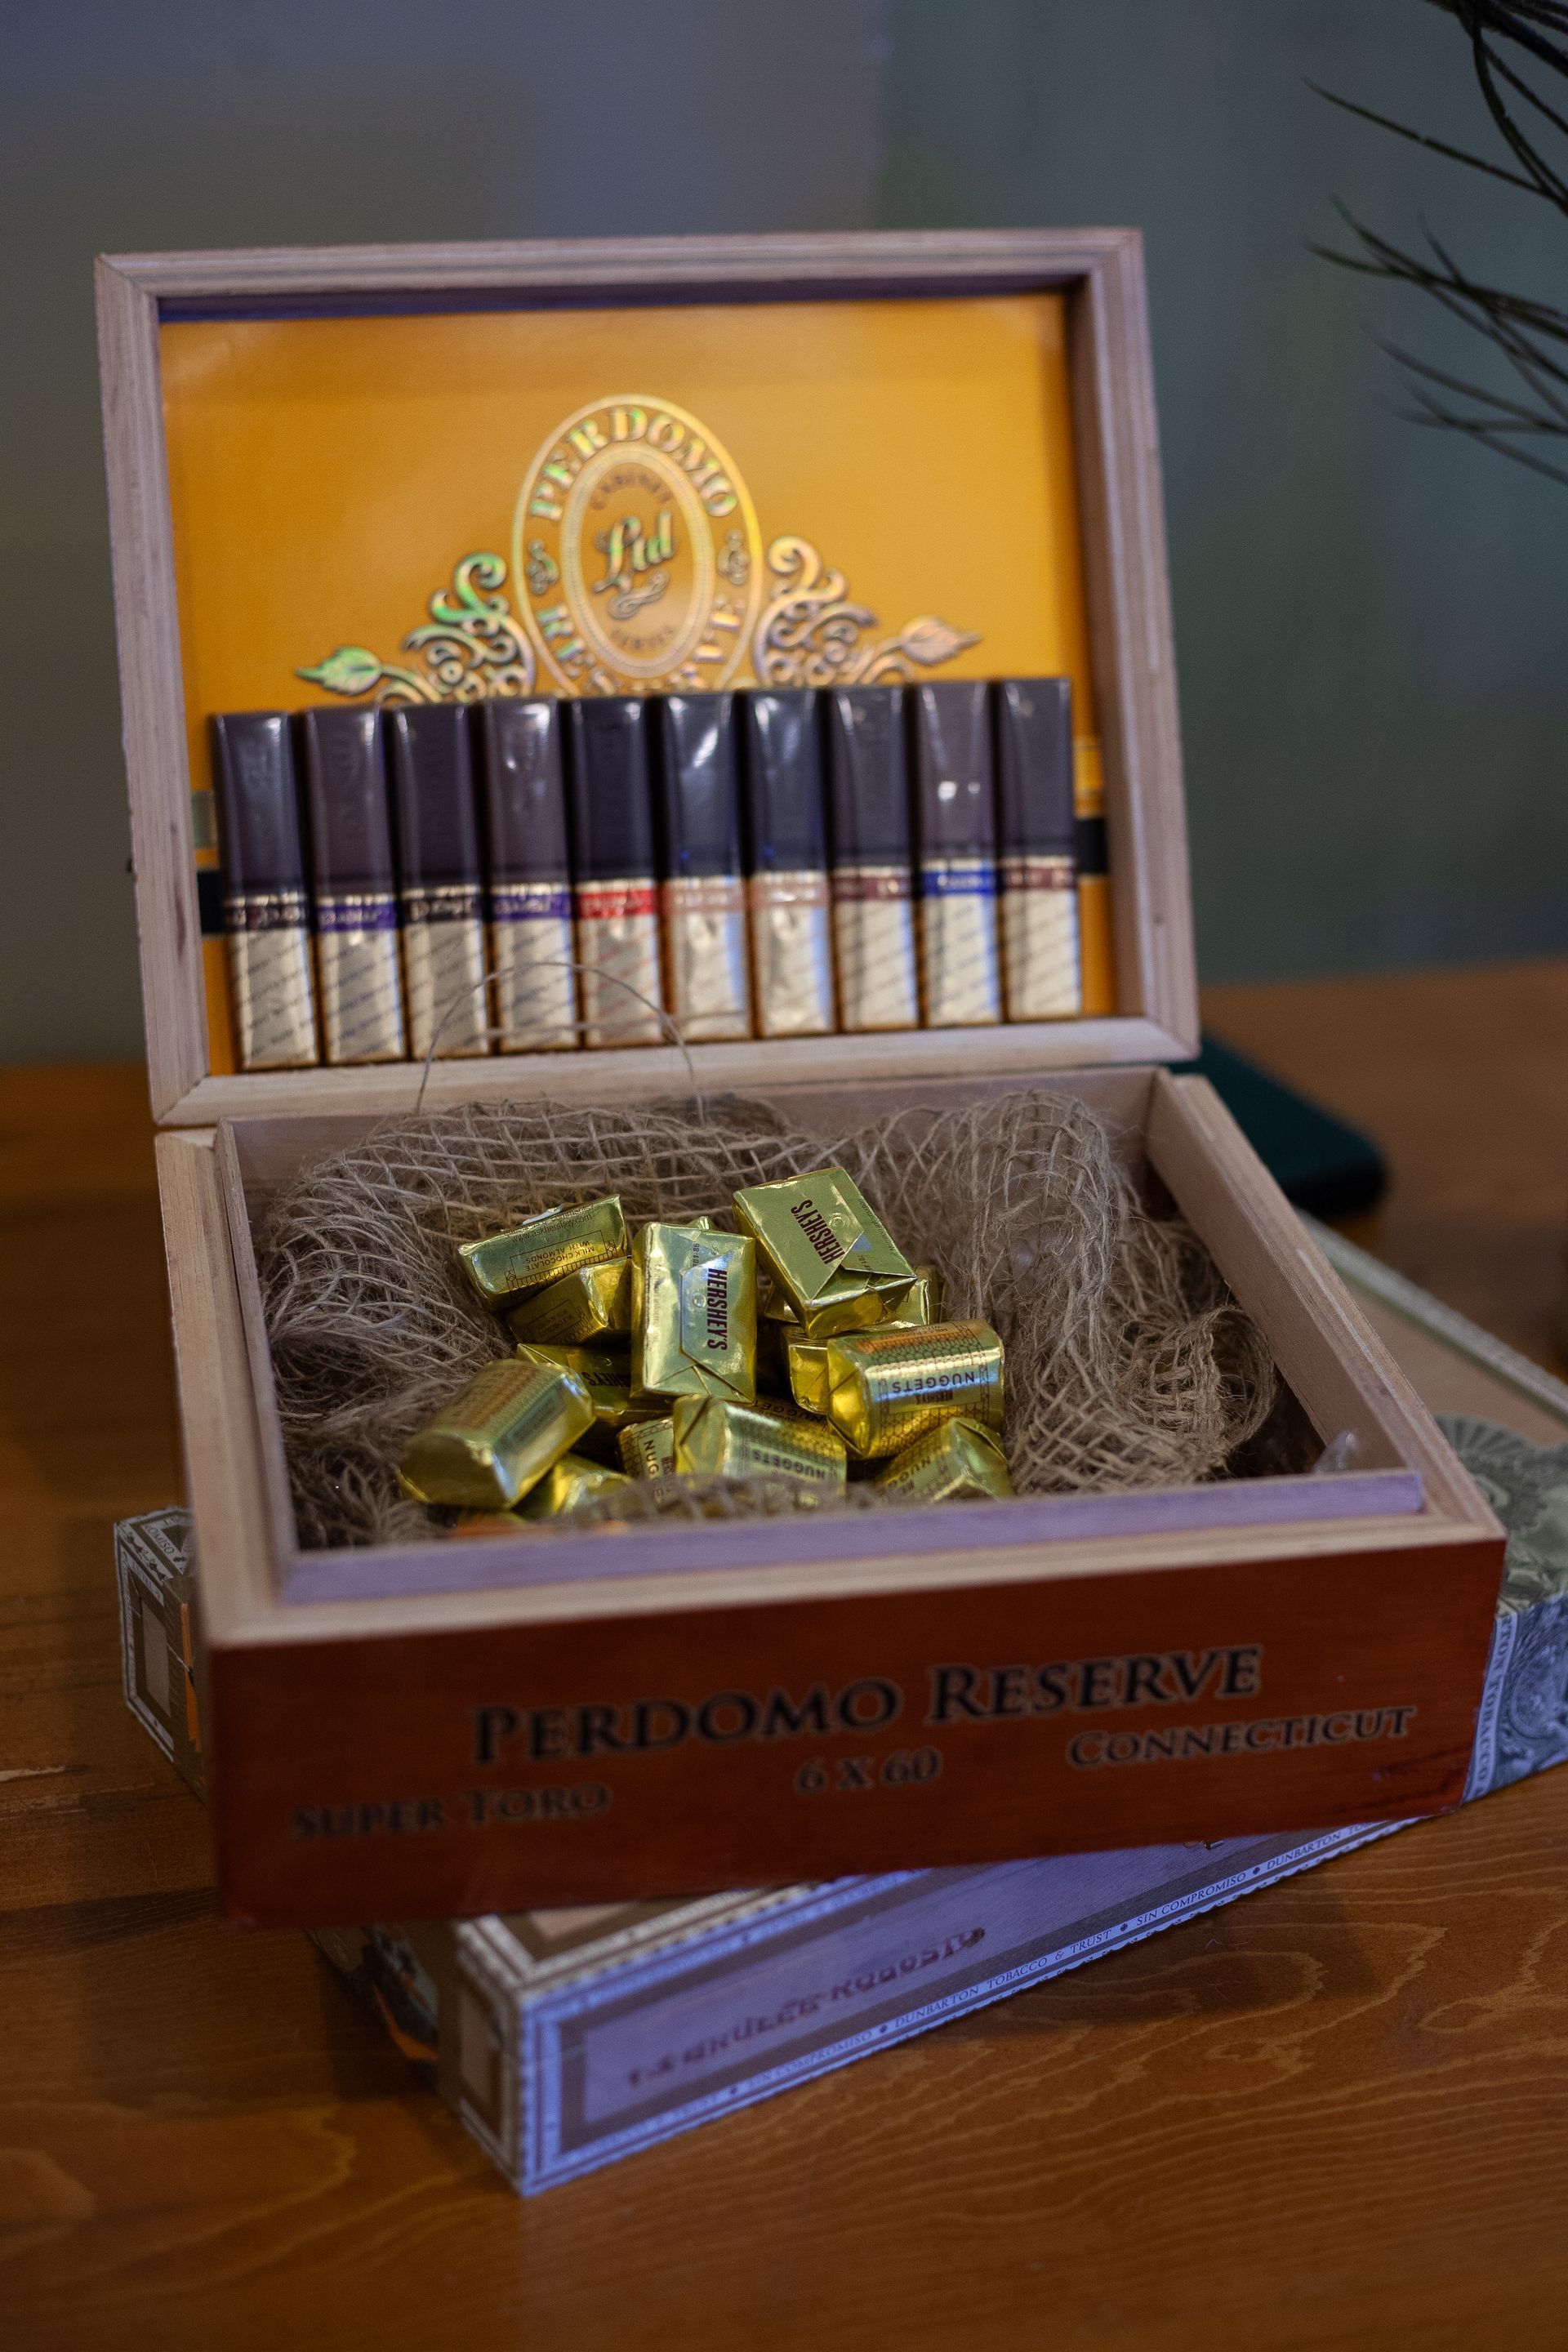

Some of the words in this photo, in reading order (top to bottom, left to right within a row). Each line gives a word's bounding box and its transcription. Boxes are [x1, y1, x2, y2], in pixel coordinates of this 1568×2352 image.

[530, 407, 737, 521] PERDOMO
[525, 1246, 565, 1264] ALMONDS
[568, 1240, 590, 1250] WITH
[574, 1245, 595, 1256] MILK
[791, 1199, 846, 1265] HERSHEY'S
[525, 1252, 573, 1271] CHOCOLATE
[706, 1267, 728, 1351] HERSHEY'S
[891, 1371, 975, 1393] NUGGETS
[753, 1400, 823, 1423] NUGGET
[471, 1677, 902, 1767] PERDOMO
[926, 1644, 1263, 1727] RESERVE
[1068, 1706, 1418, 1769] CONNECTICUT
[795, 1757, 825, 1795] 6
[883, 1746, 942, 1786] 60
[291, 1793, 448, 1842] SUPER
[464, 1782, 612, 1826] TORO
[895, 1985, 979, 2029] DUNBARTON
[987, 1957, 1048, 1989] TOBACCO
[1054, 1951, 1065, 1960] &
[1070, 1929, 1112, 1953] TRUST
[1136, 1909, 1158, 1926] SIN
[1160, 1873, 1246, 1915] COMPROMISO
[1266, 1832, 1341, 1870] DUNBARTON
